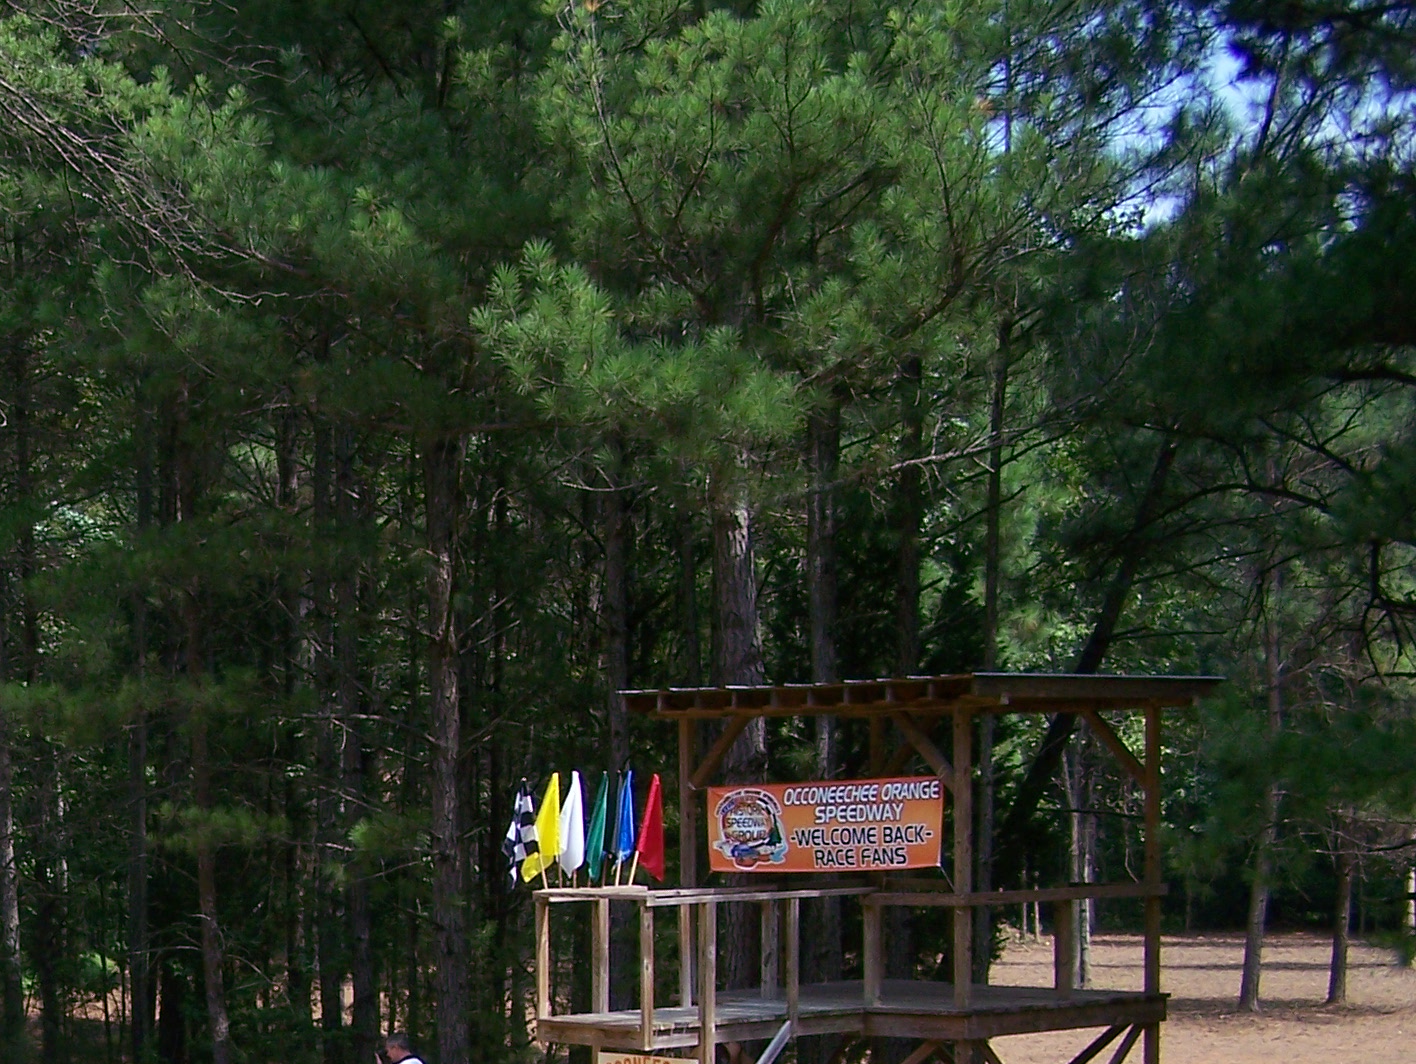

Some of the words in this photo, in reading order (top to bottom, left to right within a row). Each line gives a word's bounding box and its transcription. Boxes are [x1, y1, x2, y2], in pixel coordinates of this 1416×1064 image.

[784, 784, 877, 806] OCCONEECHEE
[881, 780, 940, 800] ORANGE
[814, 803, 904, 824] SPEEDWAY
[814, 848, 856, 867] RACE
[860, 847, 907, 867] FANS
